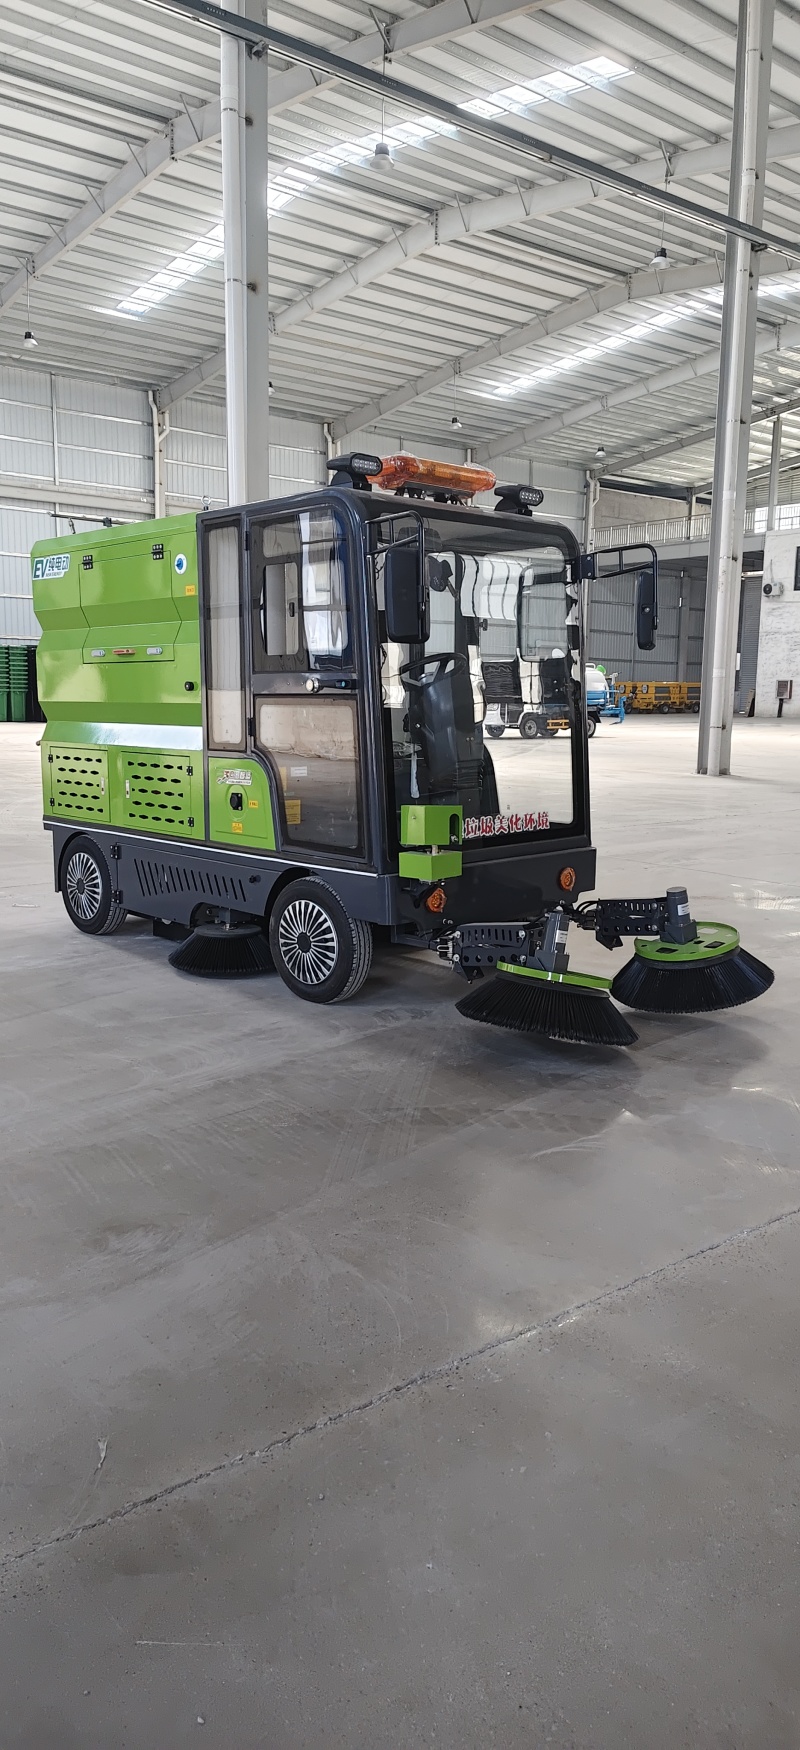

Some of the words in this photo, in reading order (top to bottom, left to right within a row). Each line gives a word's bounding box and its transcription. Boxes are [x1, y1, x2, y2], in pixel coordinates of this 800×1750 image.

[462, 812, 550, 838] 垃圾美化环境
